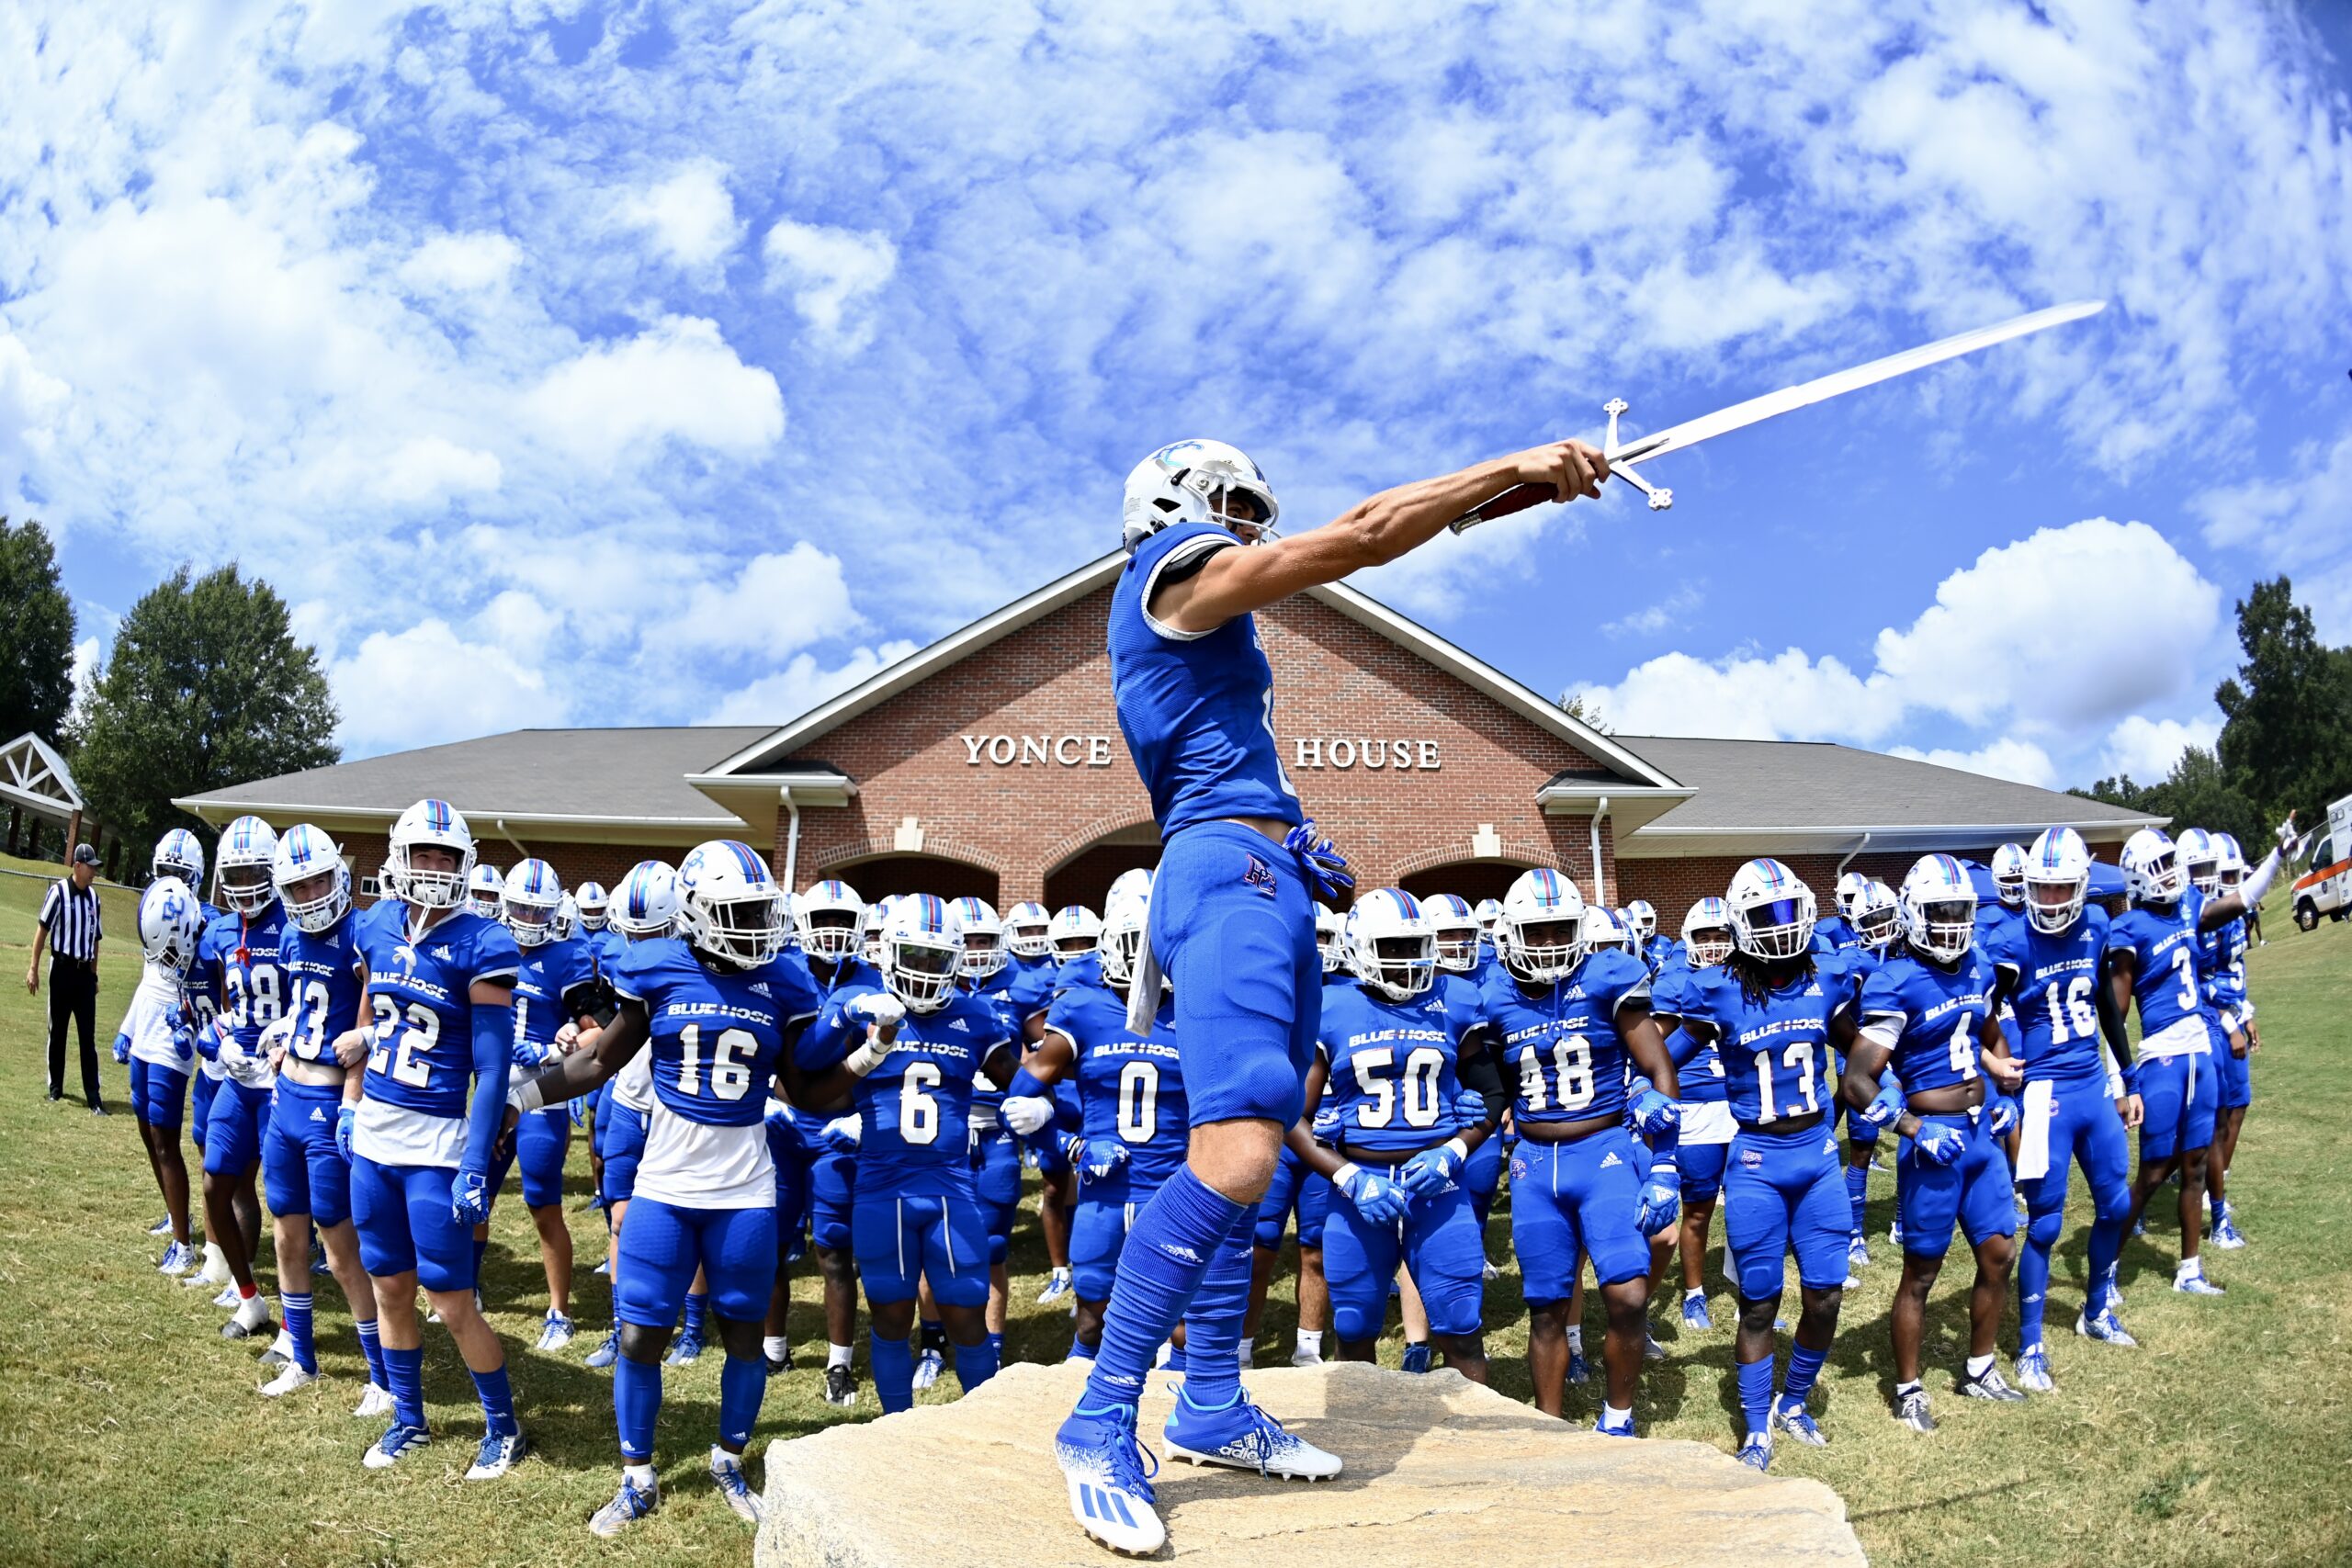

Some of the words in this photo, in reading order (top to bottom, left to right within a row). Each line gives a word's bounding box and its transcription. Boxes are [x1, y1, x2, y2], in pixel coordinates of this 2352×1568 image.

[961, 734, 1113, 767] YONCE
[1295, 737, 1442, 769] HOUSE
[304, 961, 334, 977] HOSE
[371, 972, 401, 985] BLUE
[401, 974, 449, 1000] HOSE
[515, 982, 543, 996] OSE
[2035, 960, 2064, 980] BLUE
[2066, 957, 2094, 971] HOSE
[2172, 945, 2198, 1011] 3
[226, 964, 281, 1027] 38
[291, 977, 330, 1060] 13
[668, 1002, 718, 1016] BLUE
[720, 1004, 774, 1027] HOSE
[1925, 998, 1958, 1021] BLUE
[2046, 976, 2096, 1045] 16
[367, 993, 440, 1089] 22
[922, 1042, 969, 1058] HOSE
[1093, 1043, 1137, 1057] BLUE
[1138, 1042, 1181, 1060] HOS
[1349, 1030, 1396, 1048] BLUE
[1398, 1028, 1447, 1043] HOSE
[1507, 1024, 1540, 1044] BLUE
[1740, 1021, 1782, 1046] BLUE
[1949, 1010, 1978, 1081] 4
[676, 1023, 759, 1100] 16
[1519, 1034, 1595, 1111] 48
[1753, 1042, 1819, 1125] 13
[899, 1061, 942, 1145] 6
[1117, 1060, 1159, 1143] 0
[1351, 1047, 1445, 1129] 50
